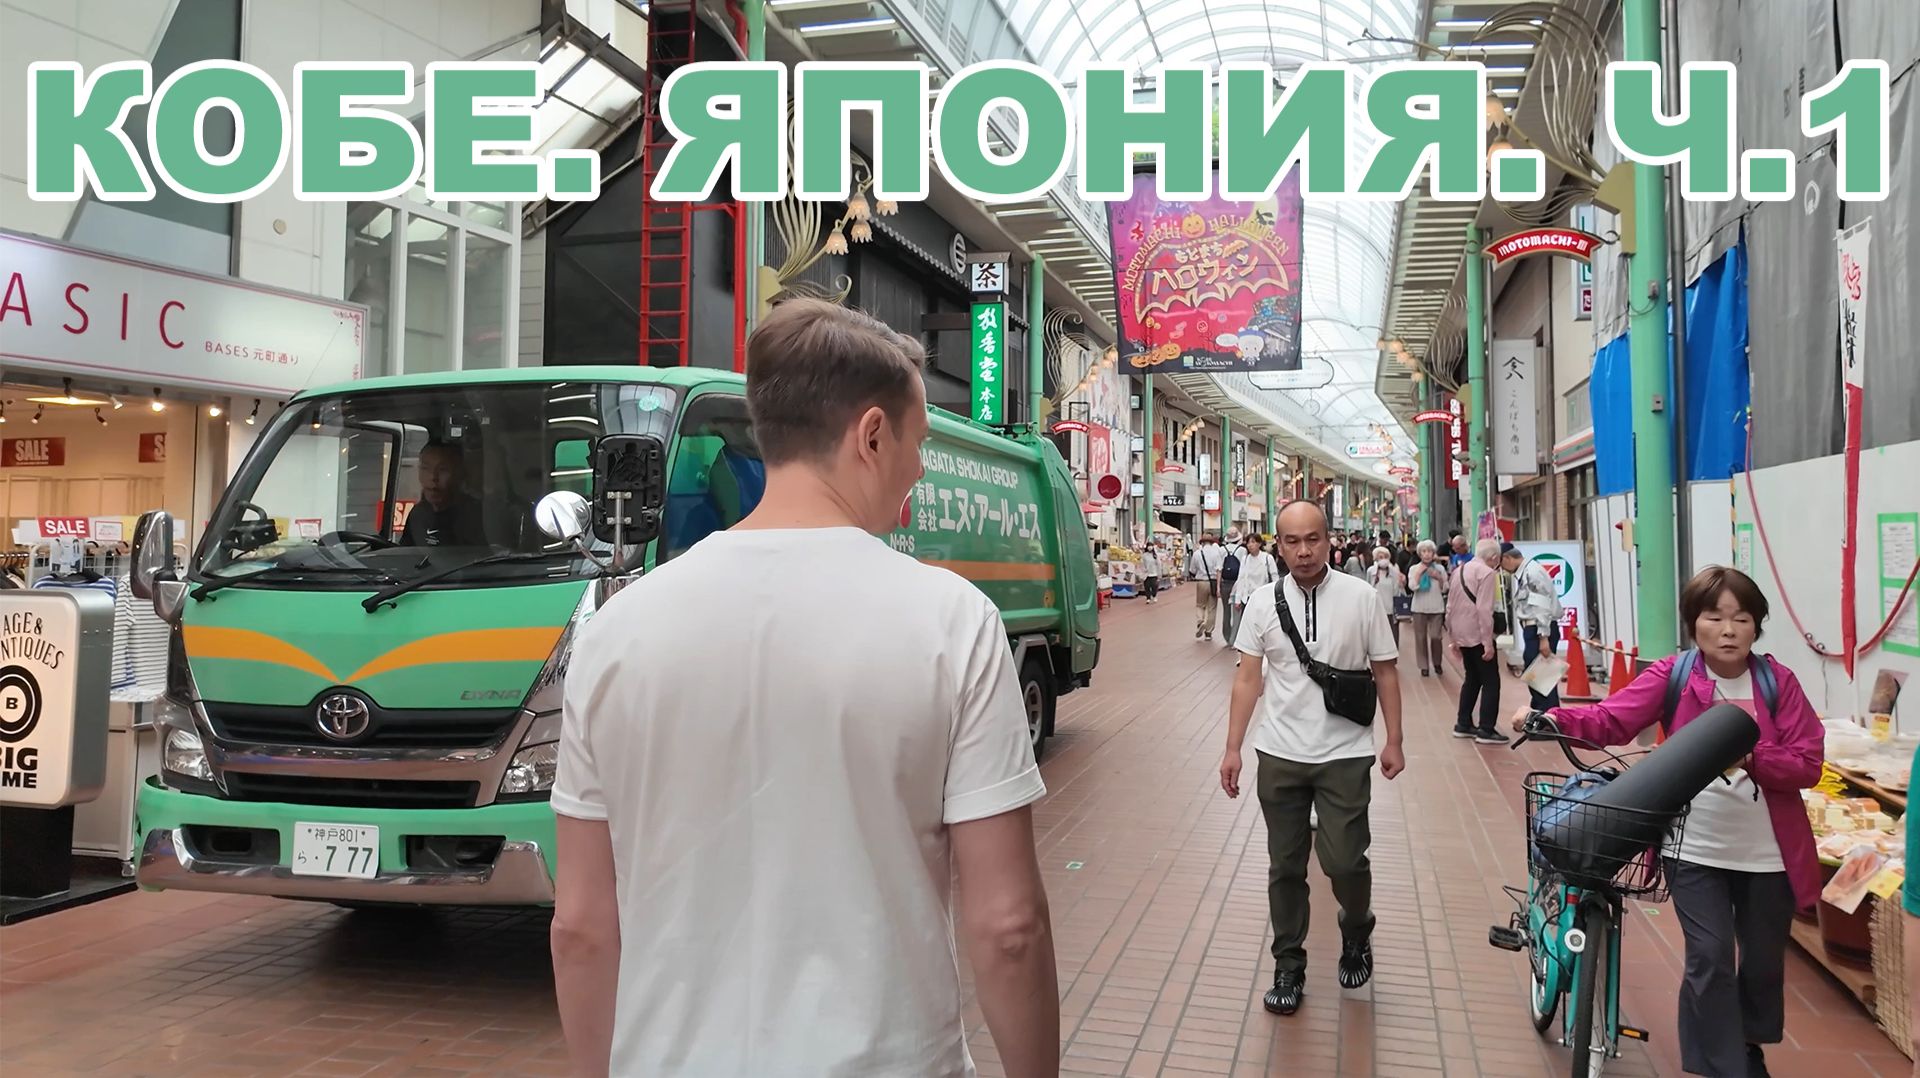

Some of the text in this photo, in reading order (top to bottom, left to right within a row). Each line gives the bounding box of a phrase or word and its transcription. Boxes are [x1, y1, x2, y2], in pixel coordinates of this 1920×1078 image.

[1152, 254, 1259, 295] ハロウィン
[0, 272, 186, 349] ASIC
[204, 340, 299, 366] BASES 元町通り
[15, 438, 50, 462] SALE
[153, 434, 167, 458] S
[920, 448, 957, 475] AGATA
[991, 465, 1018, 489] GROUP
[915, 481, 936, 505] 有限
[45, 519, 86, 534] SALE
[917, 508, 938, 532] 会社
[5, 696, 19, 710] B
[460, 689, 522, 700] DYNA
